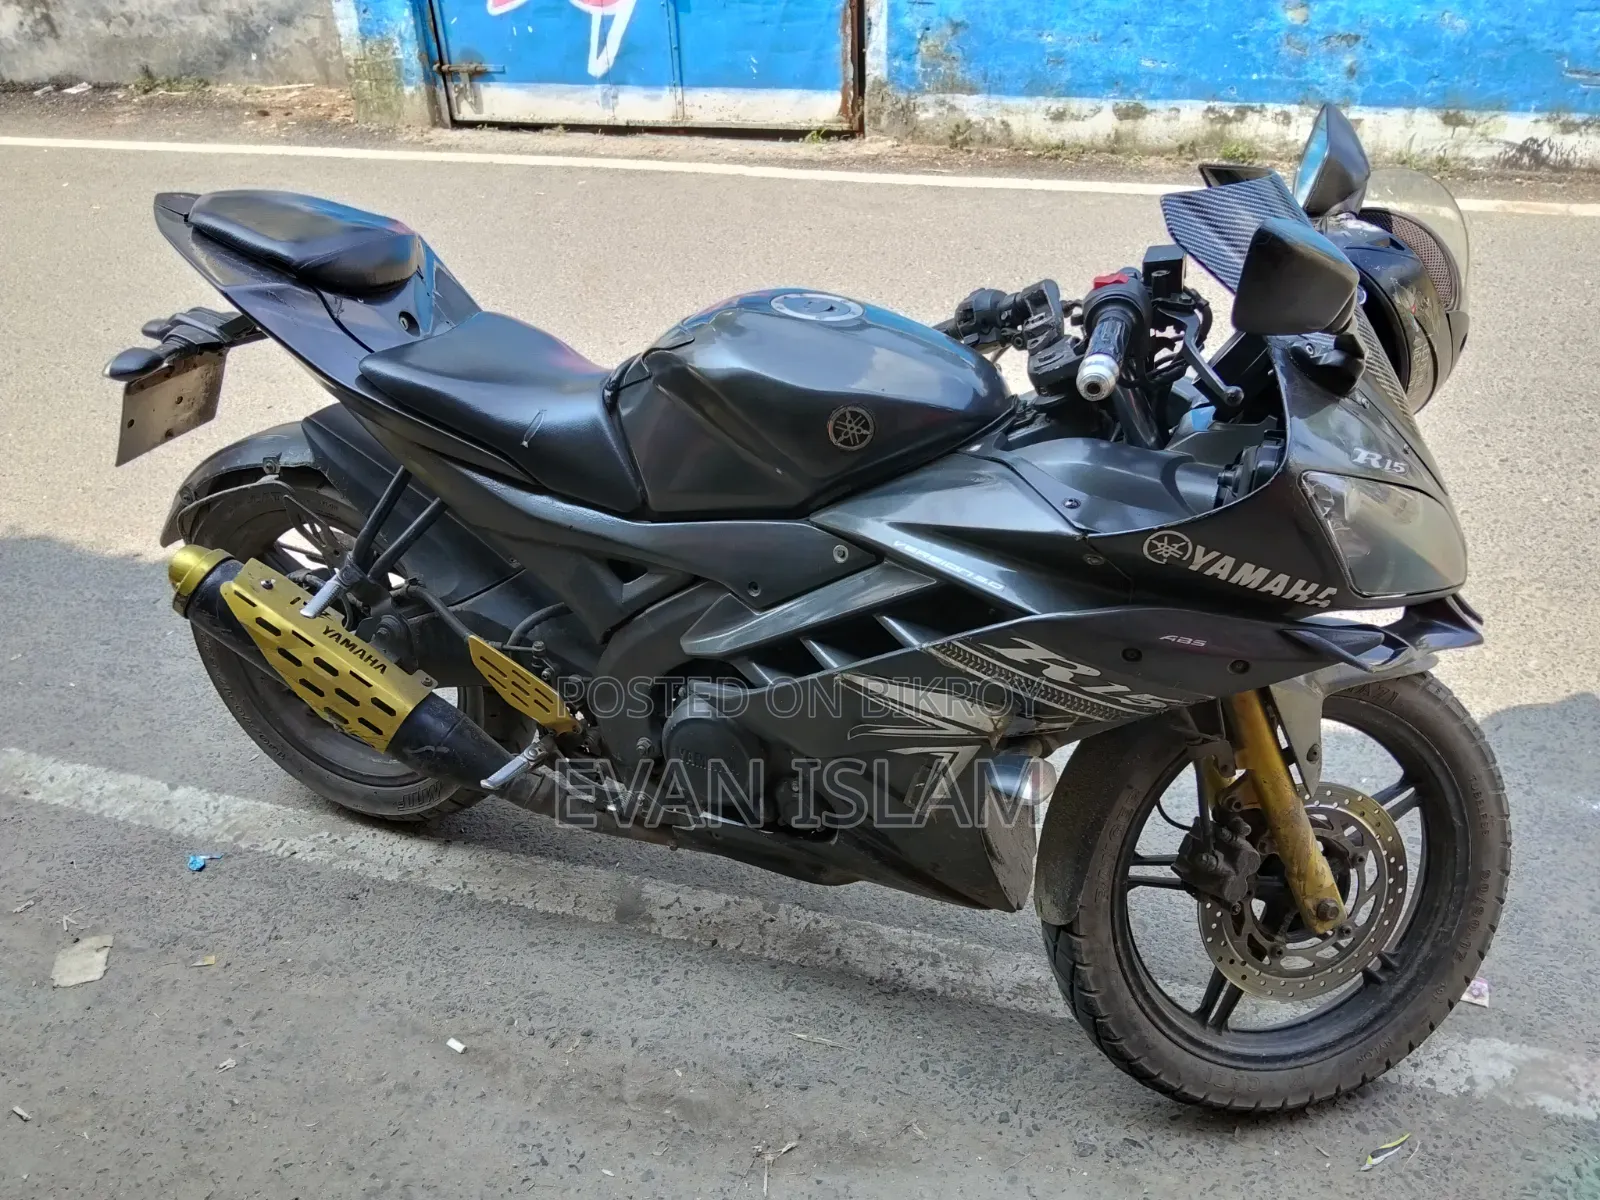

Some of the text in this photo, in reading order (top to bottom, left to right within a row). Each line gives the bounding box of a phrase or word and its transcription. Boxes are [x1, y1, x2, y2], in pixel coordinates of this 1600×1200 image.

[1352, 447, 1407, 474] R15
[322, 625, 388, 675] YAMAHA
[1158, 634, 1208, 648] ABS
[979, 636, 1168, 709] R15
